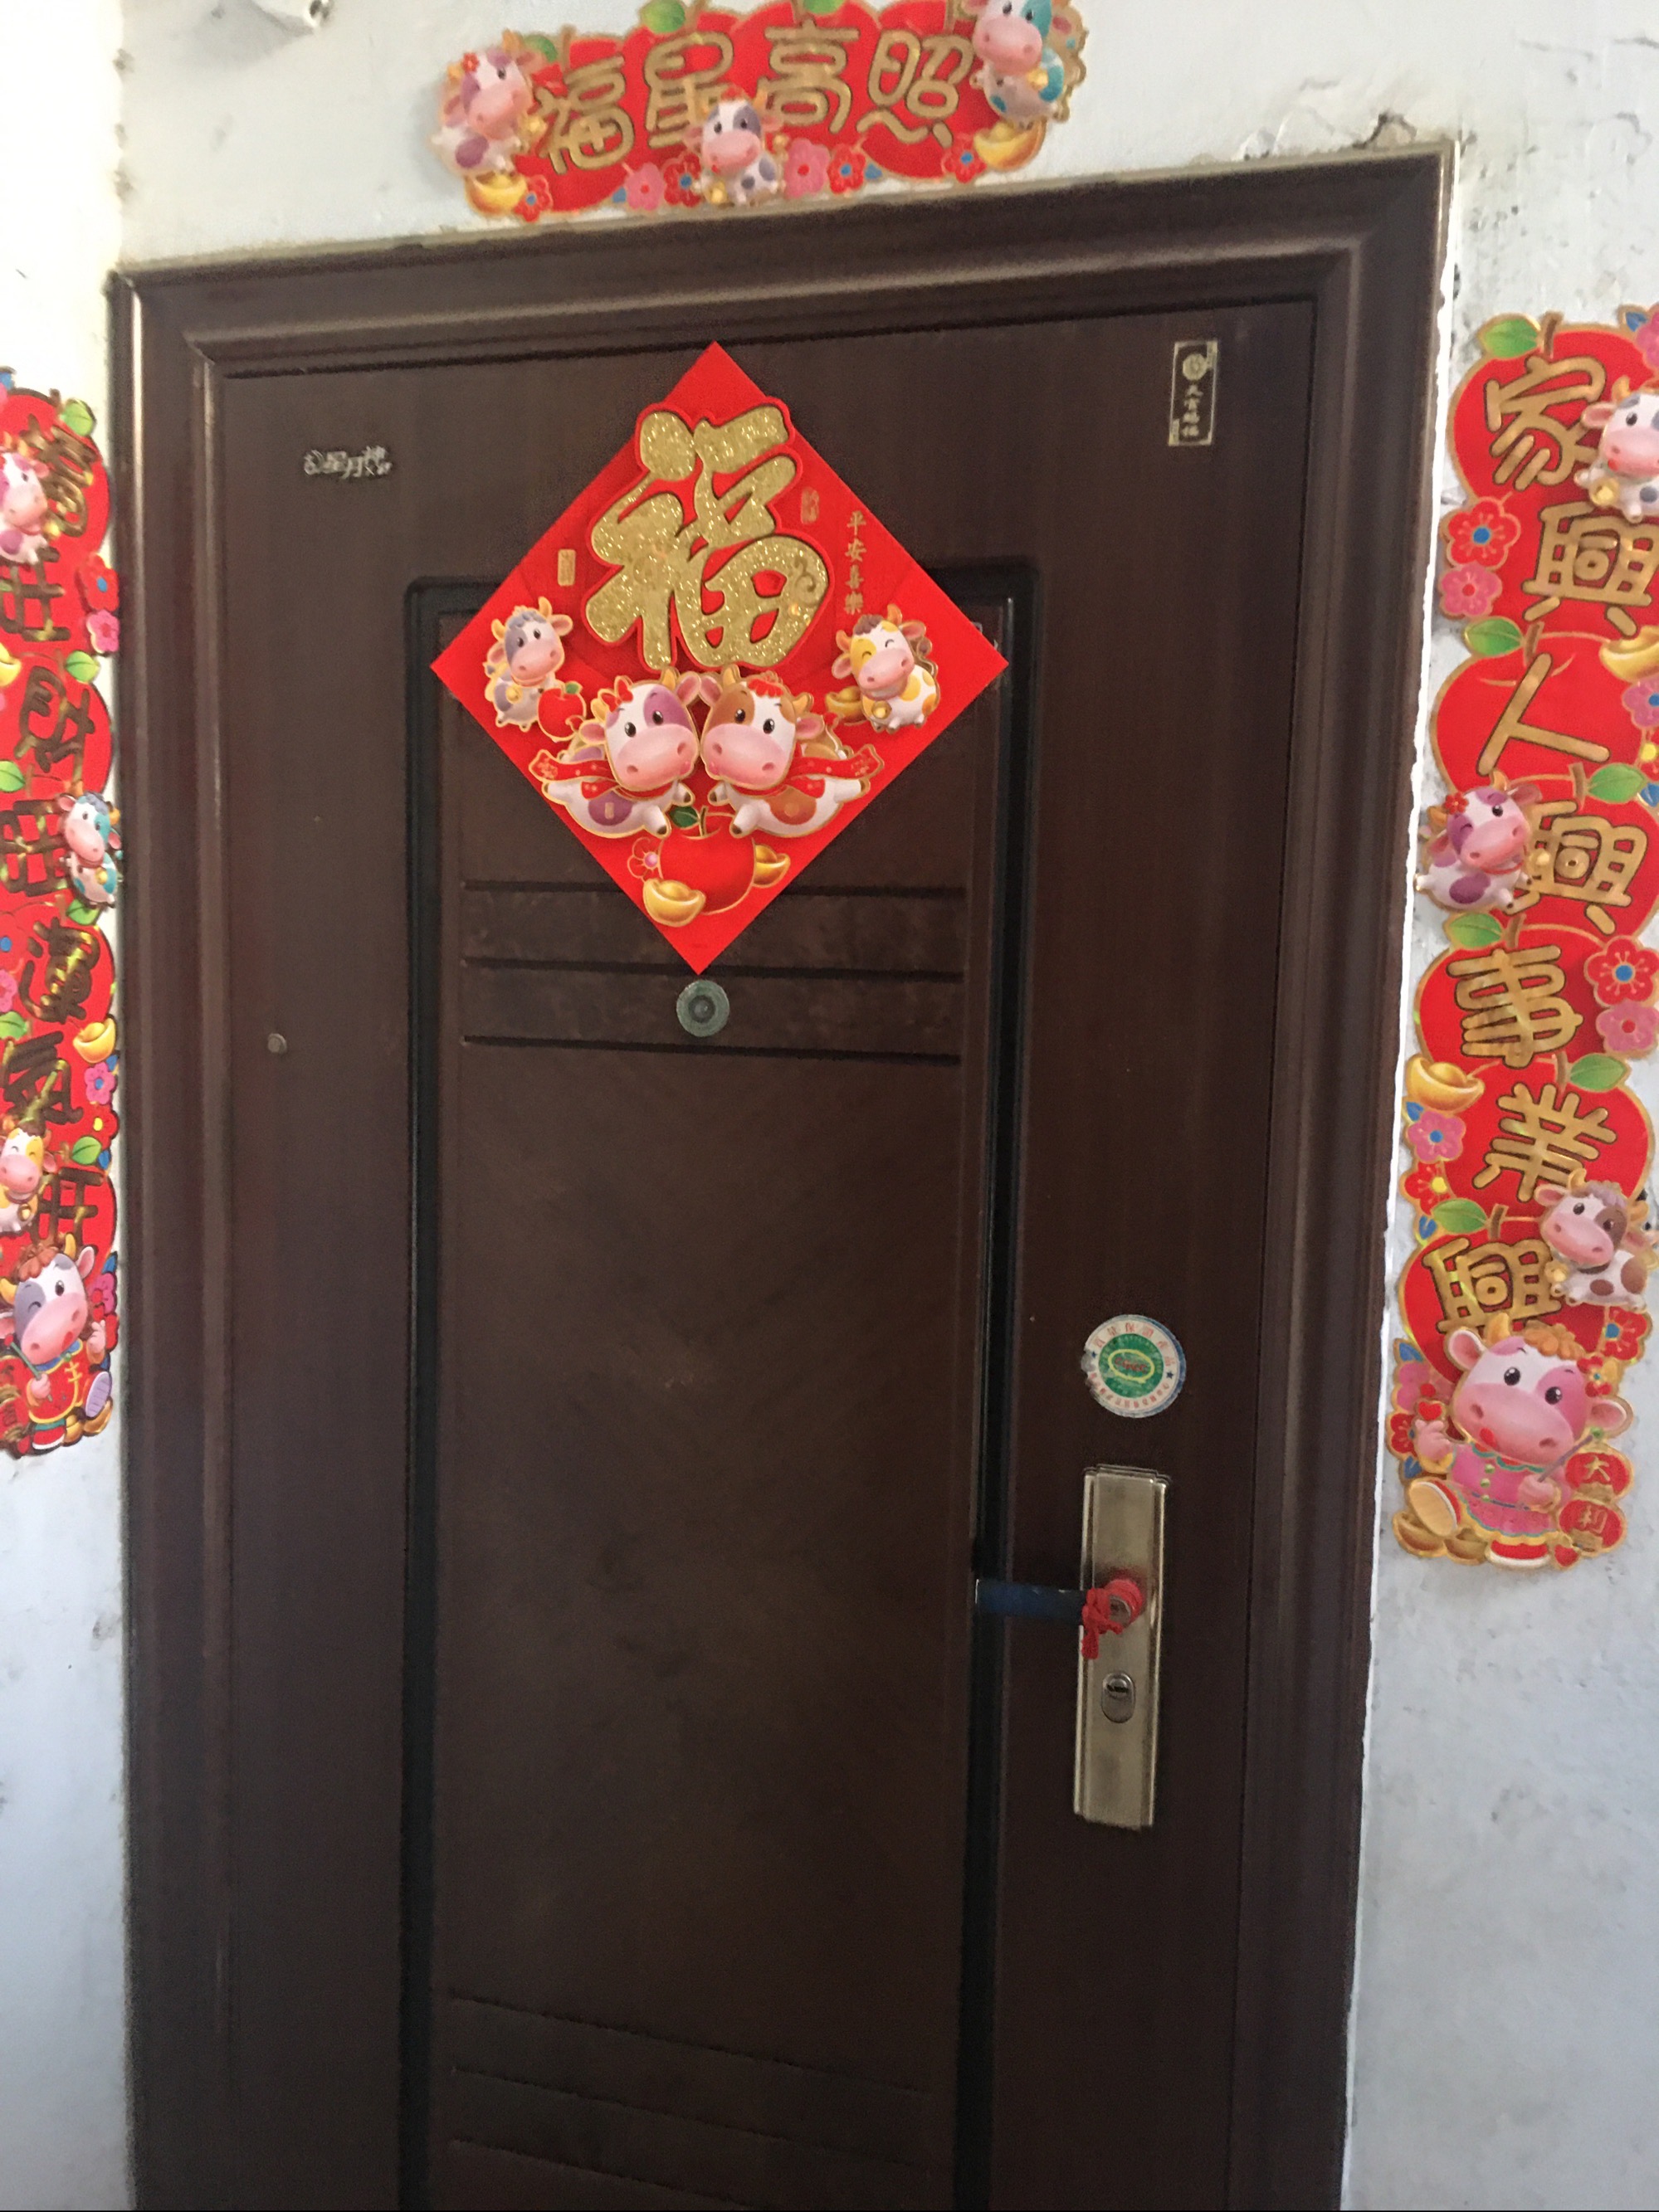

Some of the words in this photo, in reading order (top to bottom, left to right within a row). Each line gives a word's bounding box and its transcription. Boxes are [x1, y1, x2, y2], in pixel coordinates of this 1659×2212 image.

[534, 23, 976, 174] 福星高照
[585, 408, 829, 670] 福
